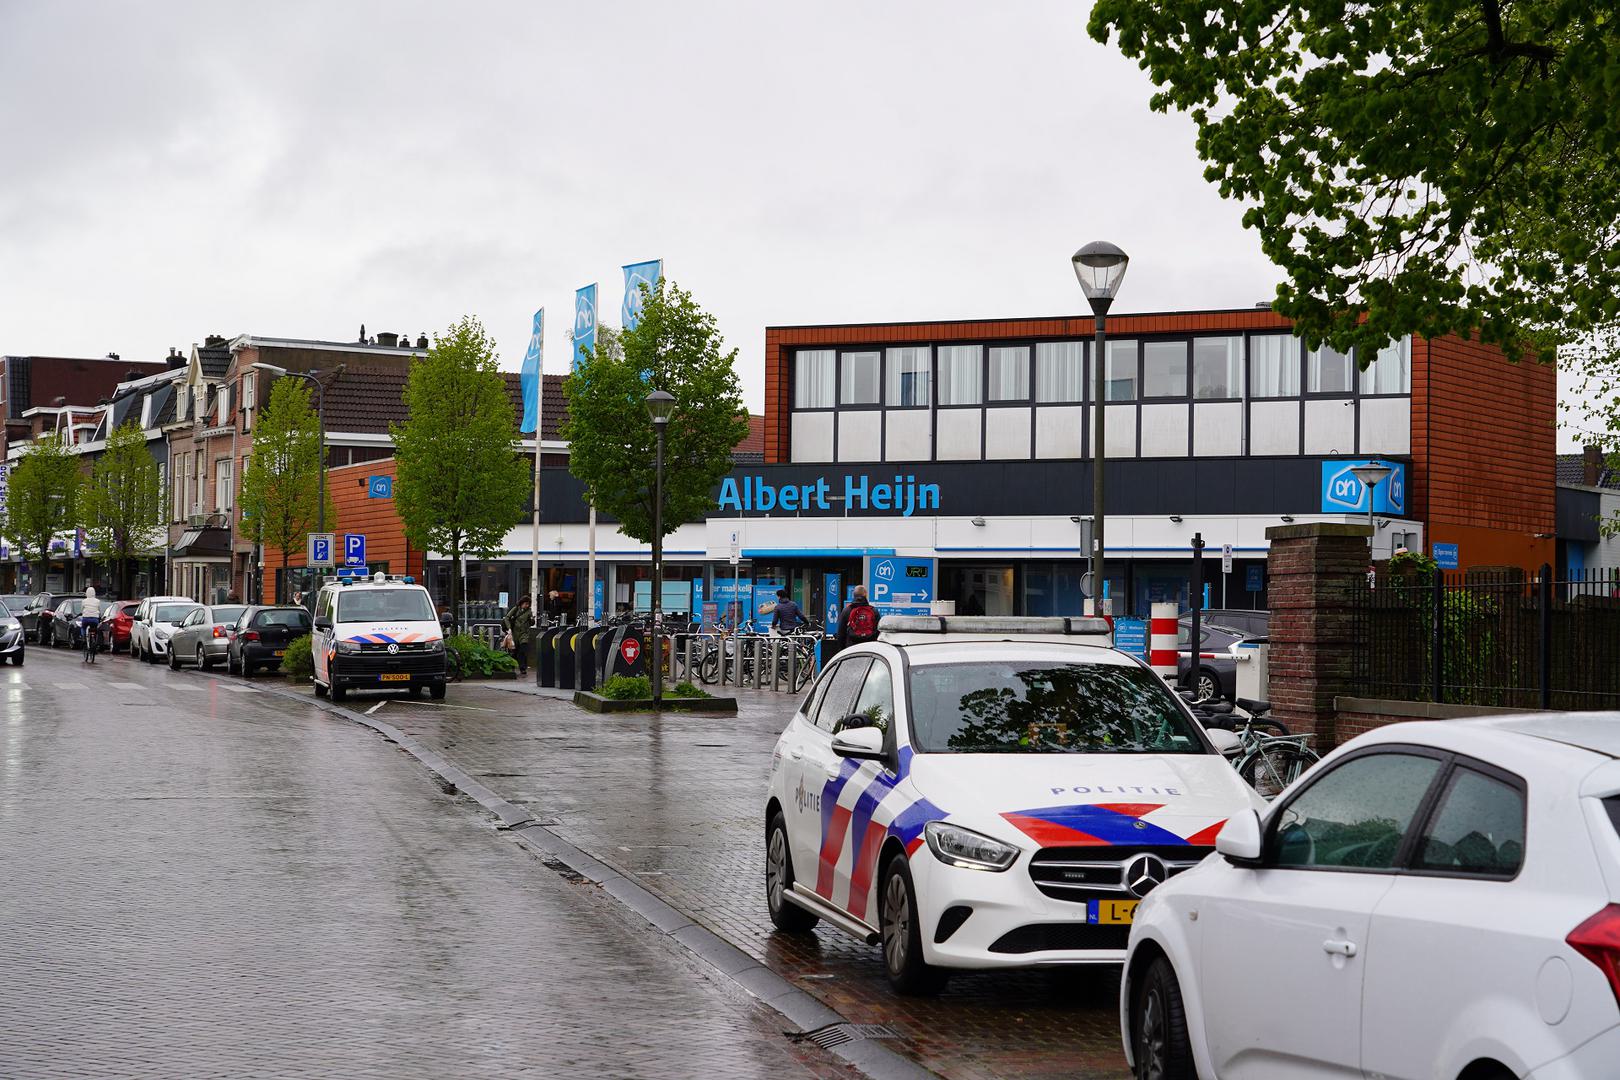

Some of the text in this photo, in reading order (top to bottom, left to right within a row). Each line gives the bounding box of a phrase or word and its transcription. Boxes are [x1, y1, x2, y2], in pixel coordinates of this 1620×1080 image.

[718, 475, 941, 518] Albert Heijn
[317, 541, 326, 553] P
[350, 537, 361, 554] P
[874, 583, 889, 600] P
[1050, 786, 1182, 796] POLITIE
[795, 786, 820, 814] POLITIE
[1089, 913, 1098, 921] NL
